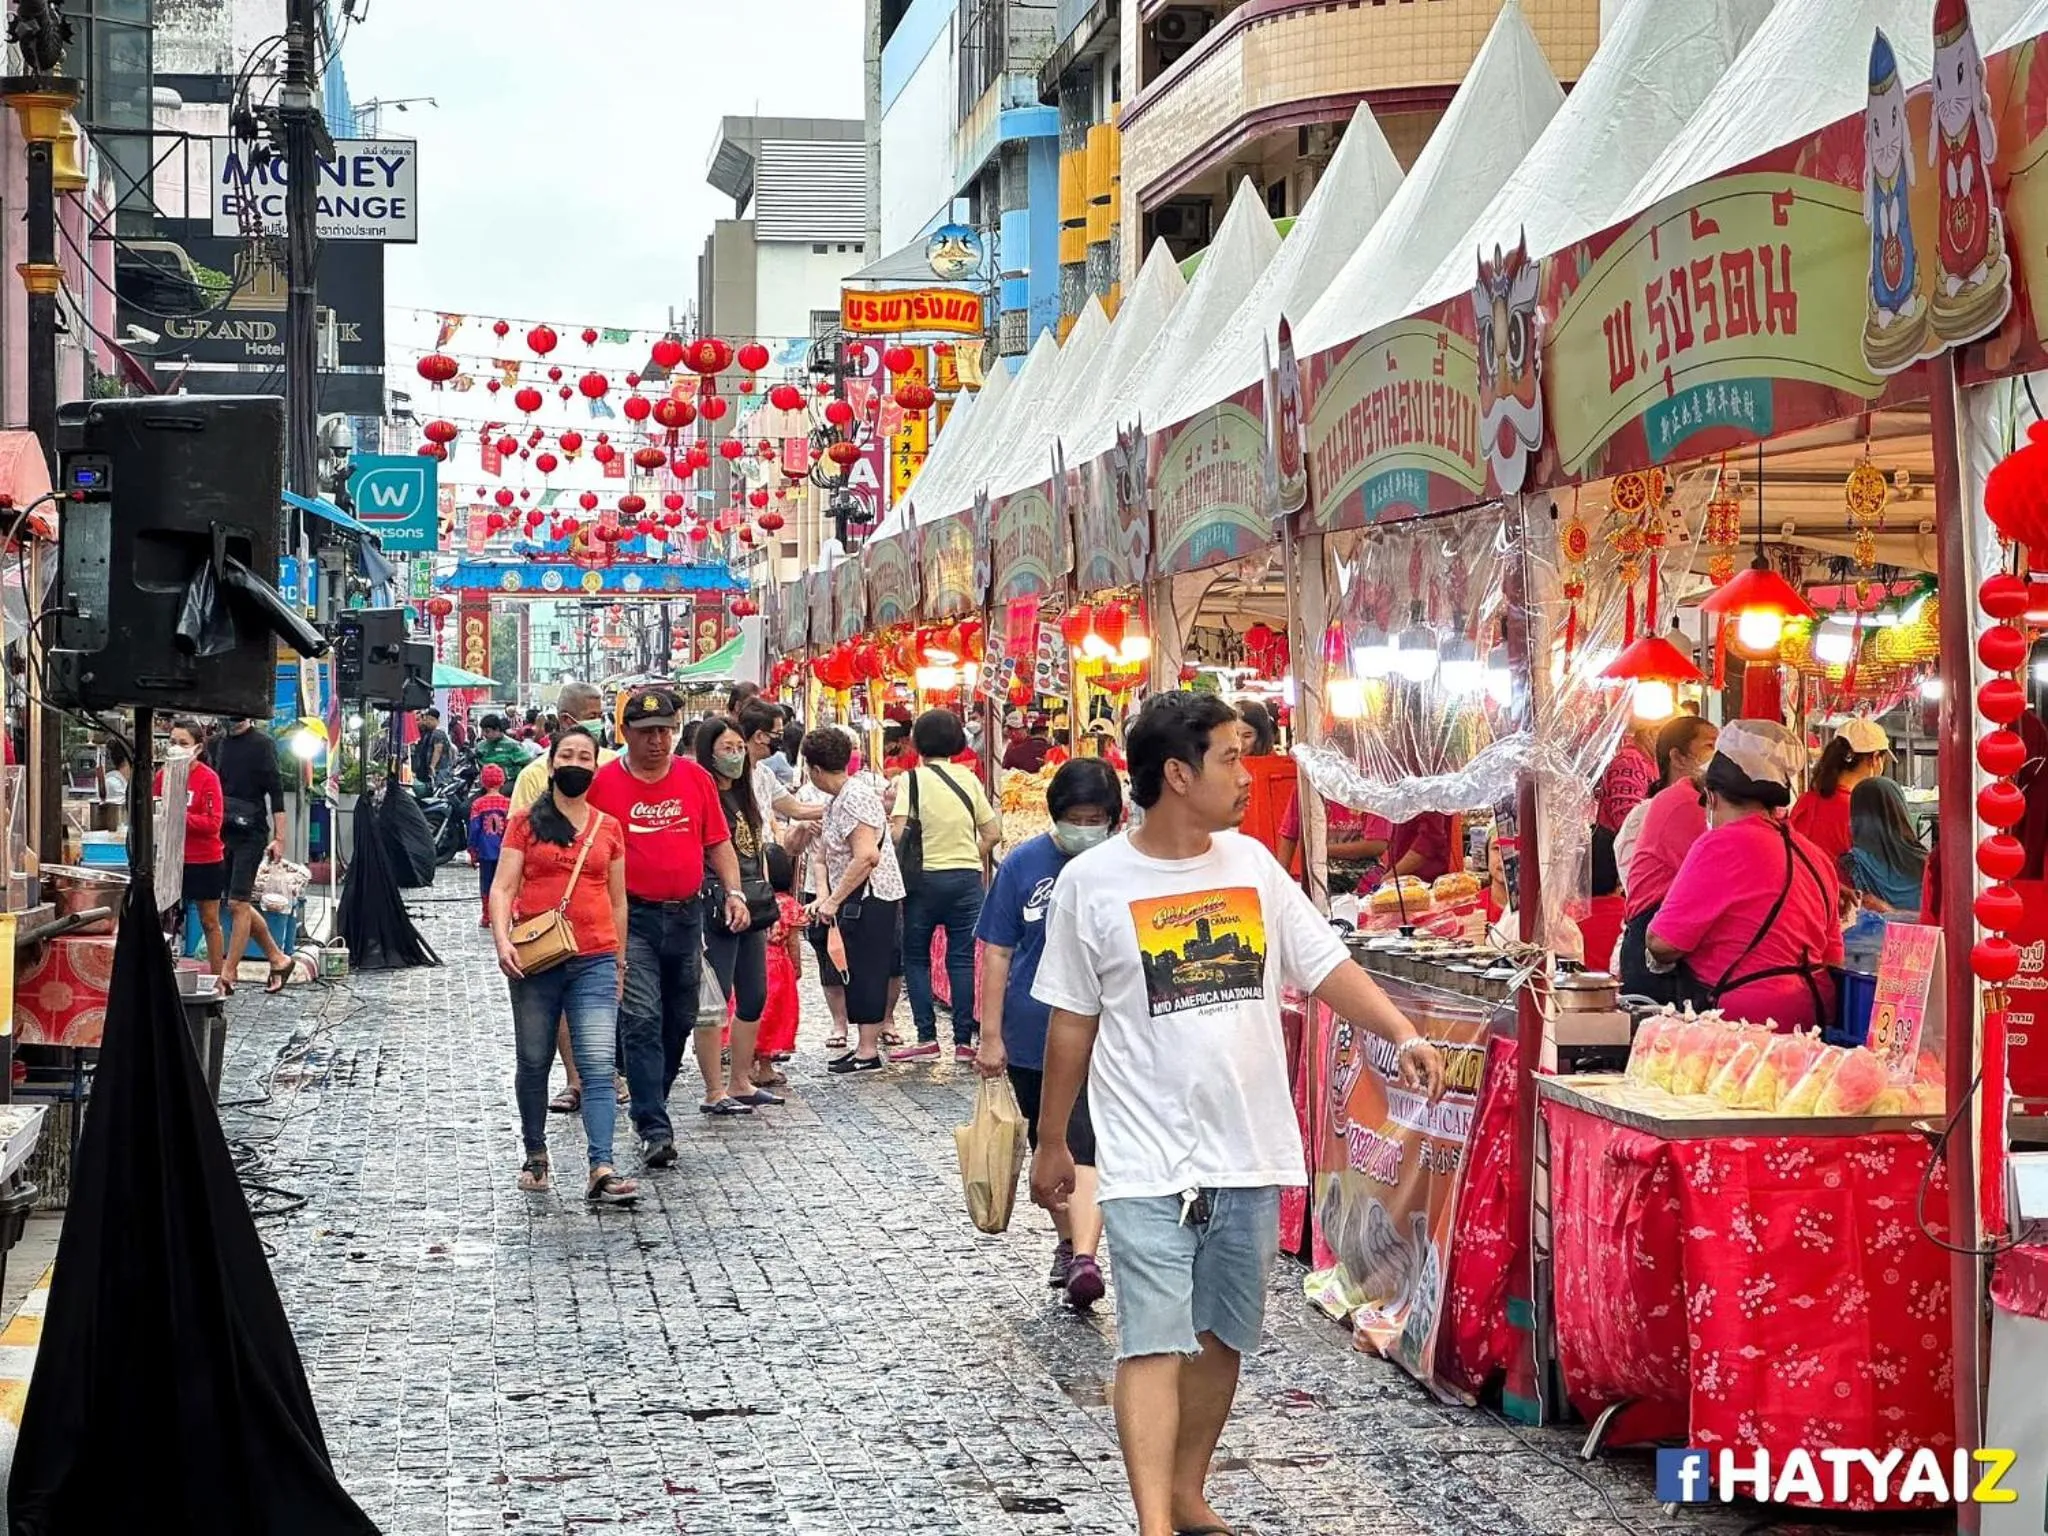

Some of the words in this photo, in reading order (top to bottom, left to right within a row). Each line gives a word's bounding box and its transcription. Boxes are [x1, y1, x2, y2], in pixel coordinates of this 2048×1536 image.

[222, 195, 406, 219] EXCANGE
[848, 293, 978, 328] บูรพารังนก
[164, 319, 276, 342] GRAND
[245, 342, 285, 356] Hotel
[373, 526, 424, 539] tsons
[1153, 1003, 1173, 1016] MID
[1174, 990, 1219, 1011] AMERICA
[1220, 986, 1263, 1002] NATIONAL
